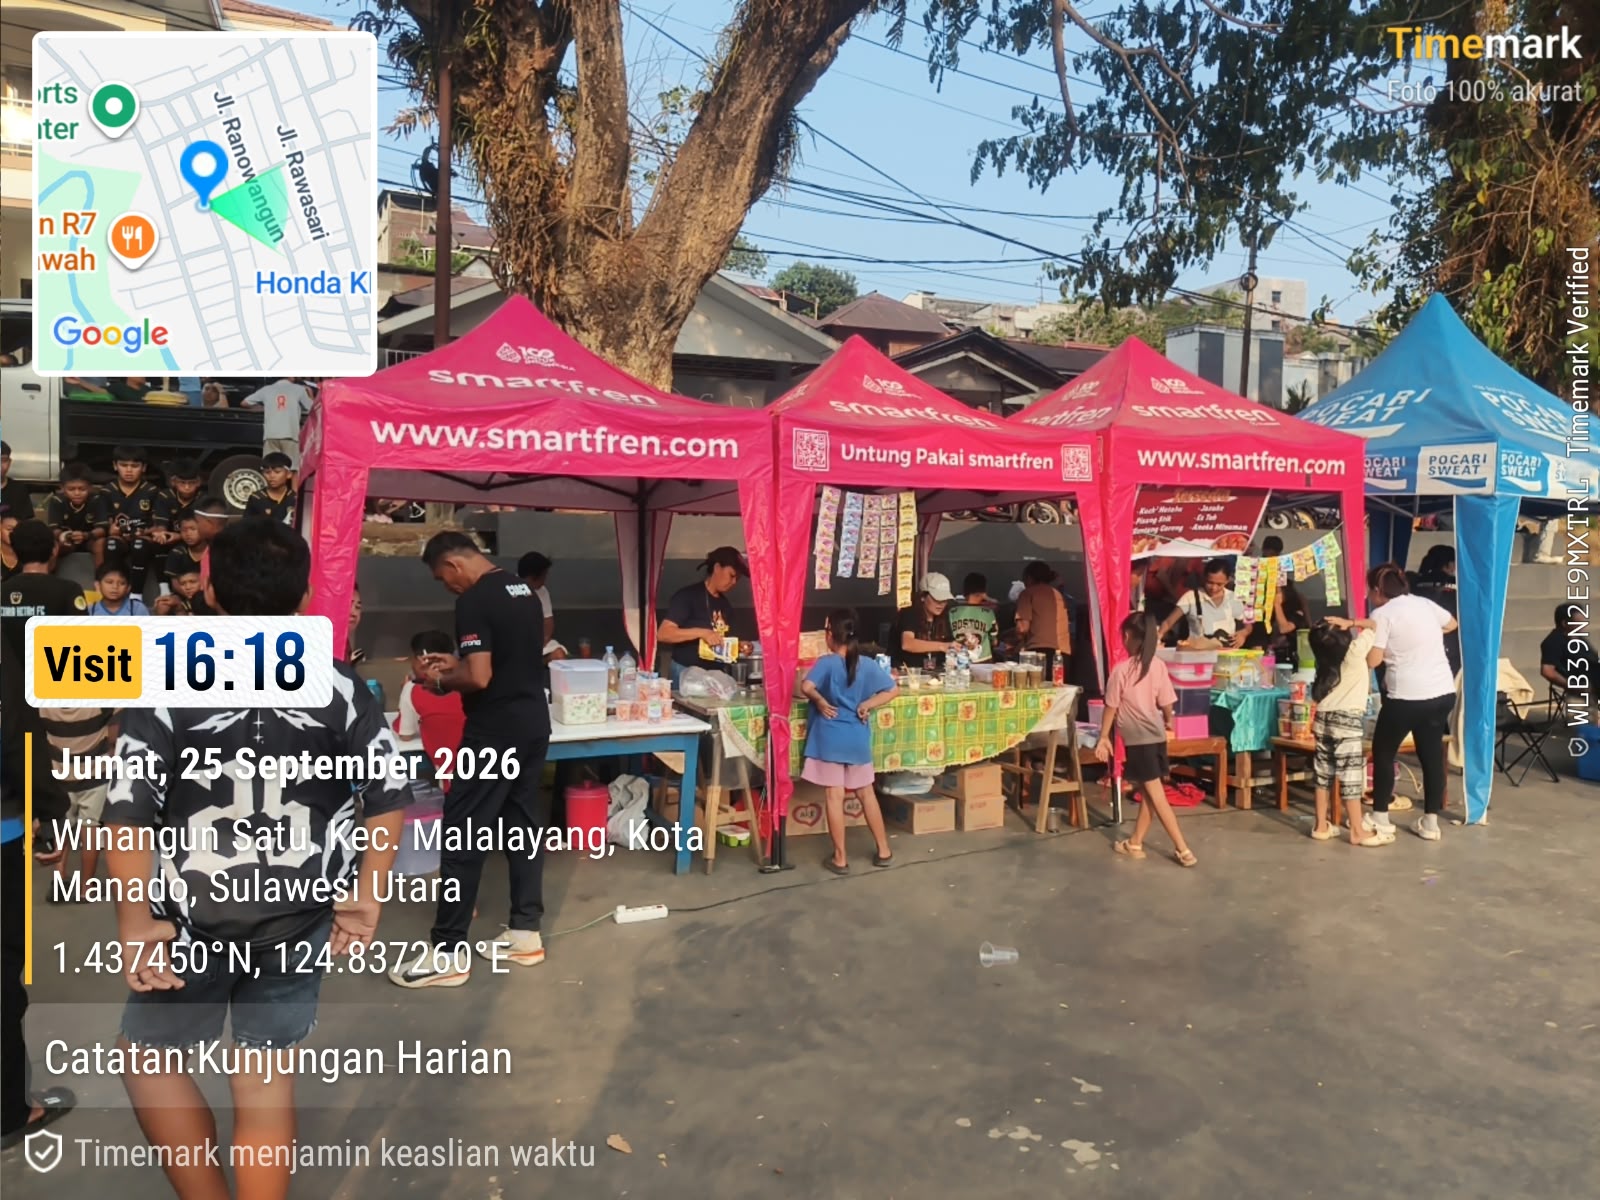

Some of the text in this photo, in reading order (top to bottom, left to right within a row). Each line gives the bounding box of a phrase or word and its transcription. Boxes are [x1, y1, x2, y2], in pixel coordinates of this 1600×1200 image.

[428, 370, 657, 405] smartfren
[829, 400, 999, 428] smartfren
[1132, 404, 1276, 423] smartfren
[370, 421, 739, 458] www.smartfren.com
[841, 444, 1054, 470] Untung Pakai smartfren
[1137, 450, 1345, 475] www.smartfren.com
[1364, 456, 1405, 467] OCARI
[1429, 454, 1487, 465] POCARI
[1501, 454, 1541, 467] POCARI
[1364, 467, 1400, 478] WEAT
[1428, 465, 1480, 476] SWEAT
[1501, 465, 1537, 477] SWEAT
[952, 618, 987, 633] BOSTON
